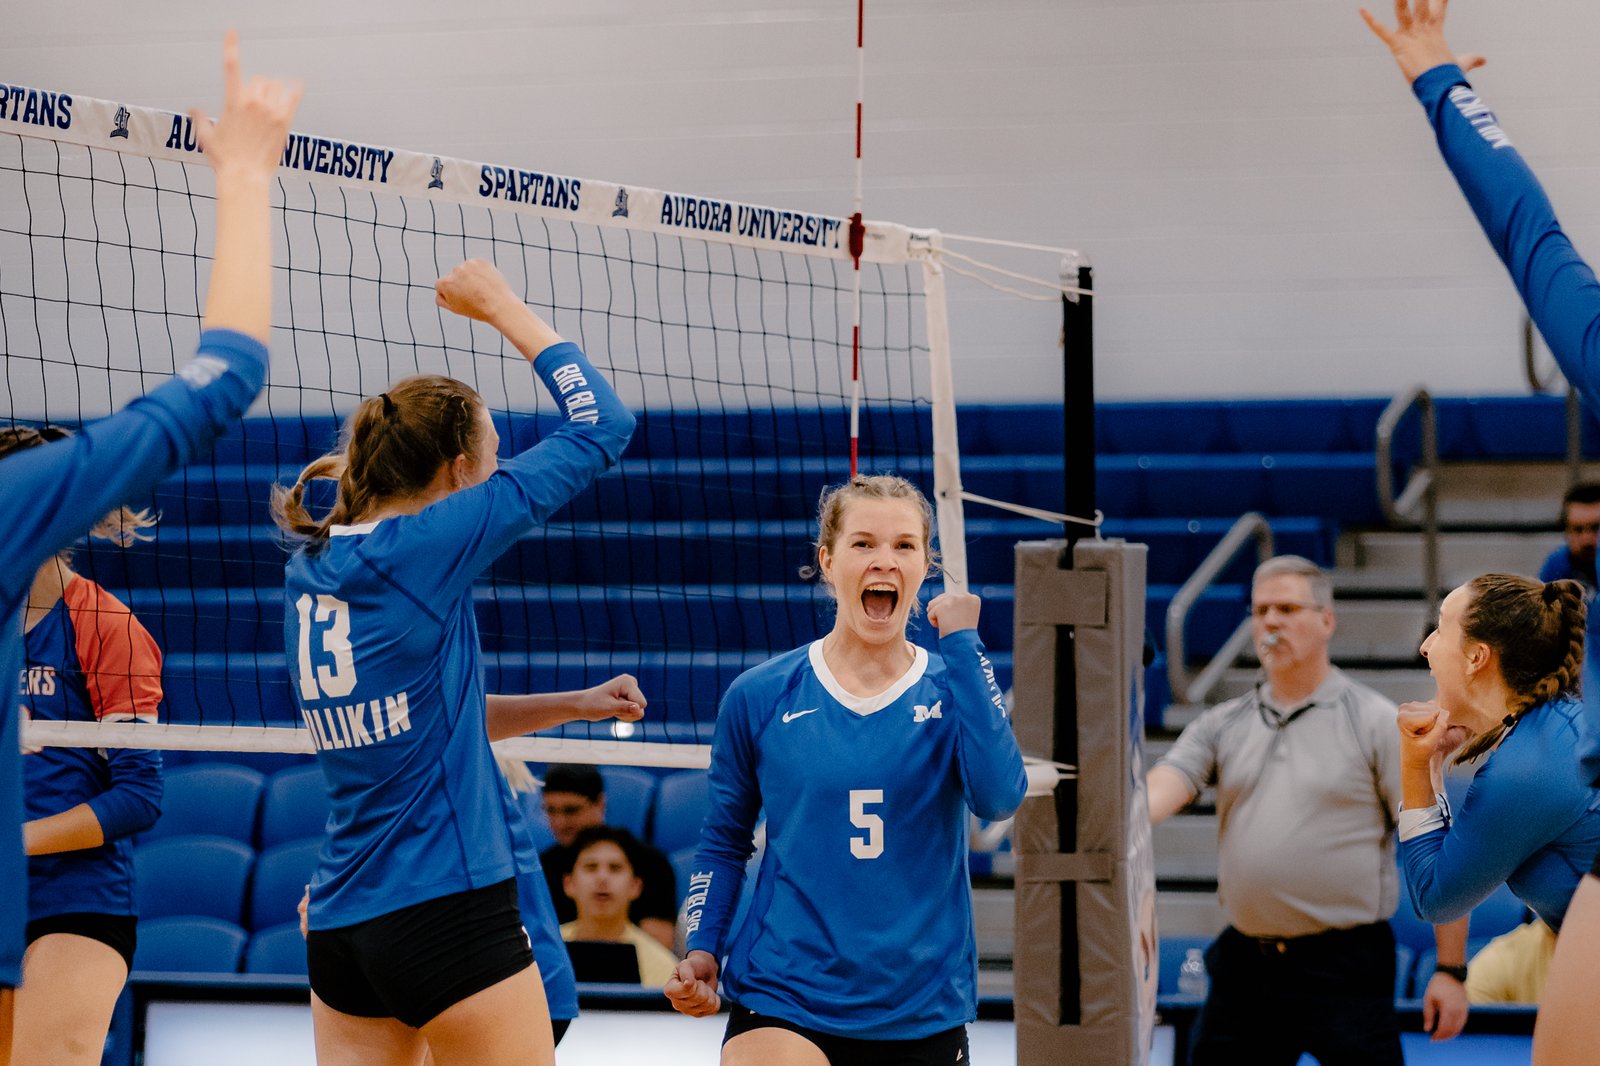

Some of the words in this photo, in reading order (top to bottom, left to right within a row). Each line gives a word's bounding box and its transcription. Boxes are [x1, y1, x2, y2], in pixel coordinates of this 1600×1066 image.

[279, 134, 394, 184] NIVERSITY
[479, 164, 582, 212] SPARTANS
[660, 193, 732, 234] AURORA
[738, 205, 841, 250] UNIVERSITY
[552, 363, 588, 395] BIG
[565, 390, 600, 426] BLU
[296, 593, 358, 701] 13
[301, 691, 412, 751] ILLIKIN
[913, 699, 943, 723] M
[849, 789, 884, 860] 5
